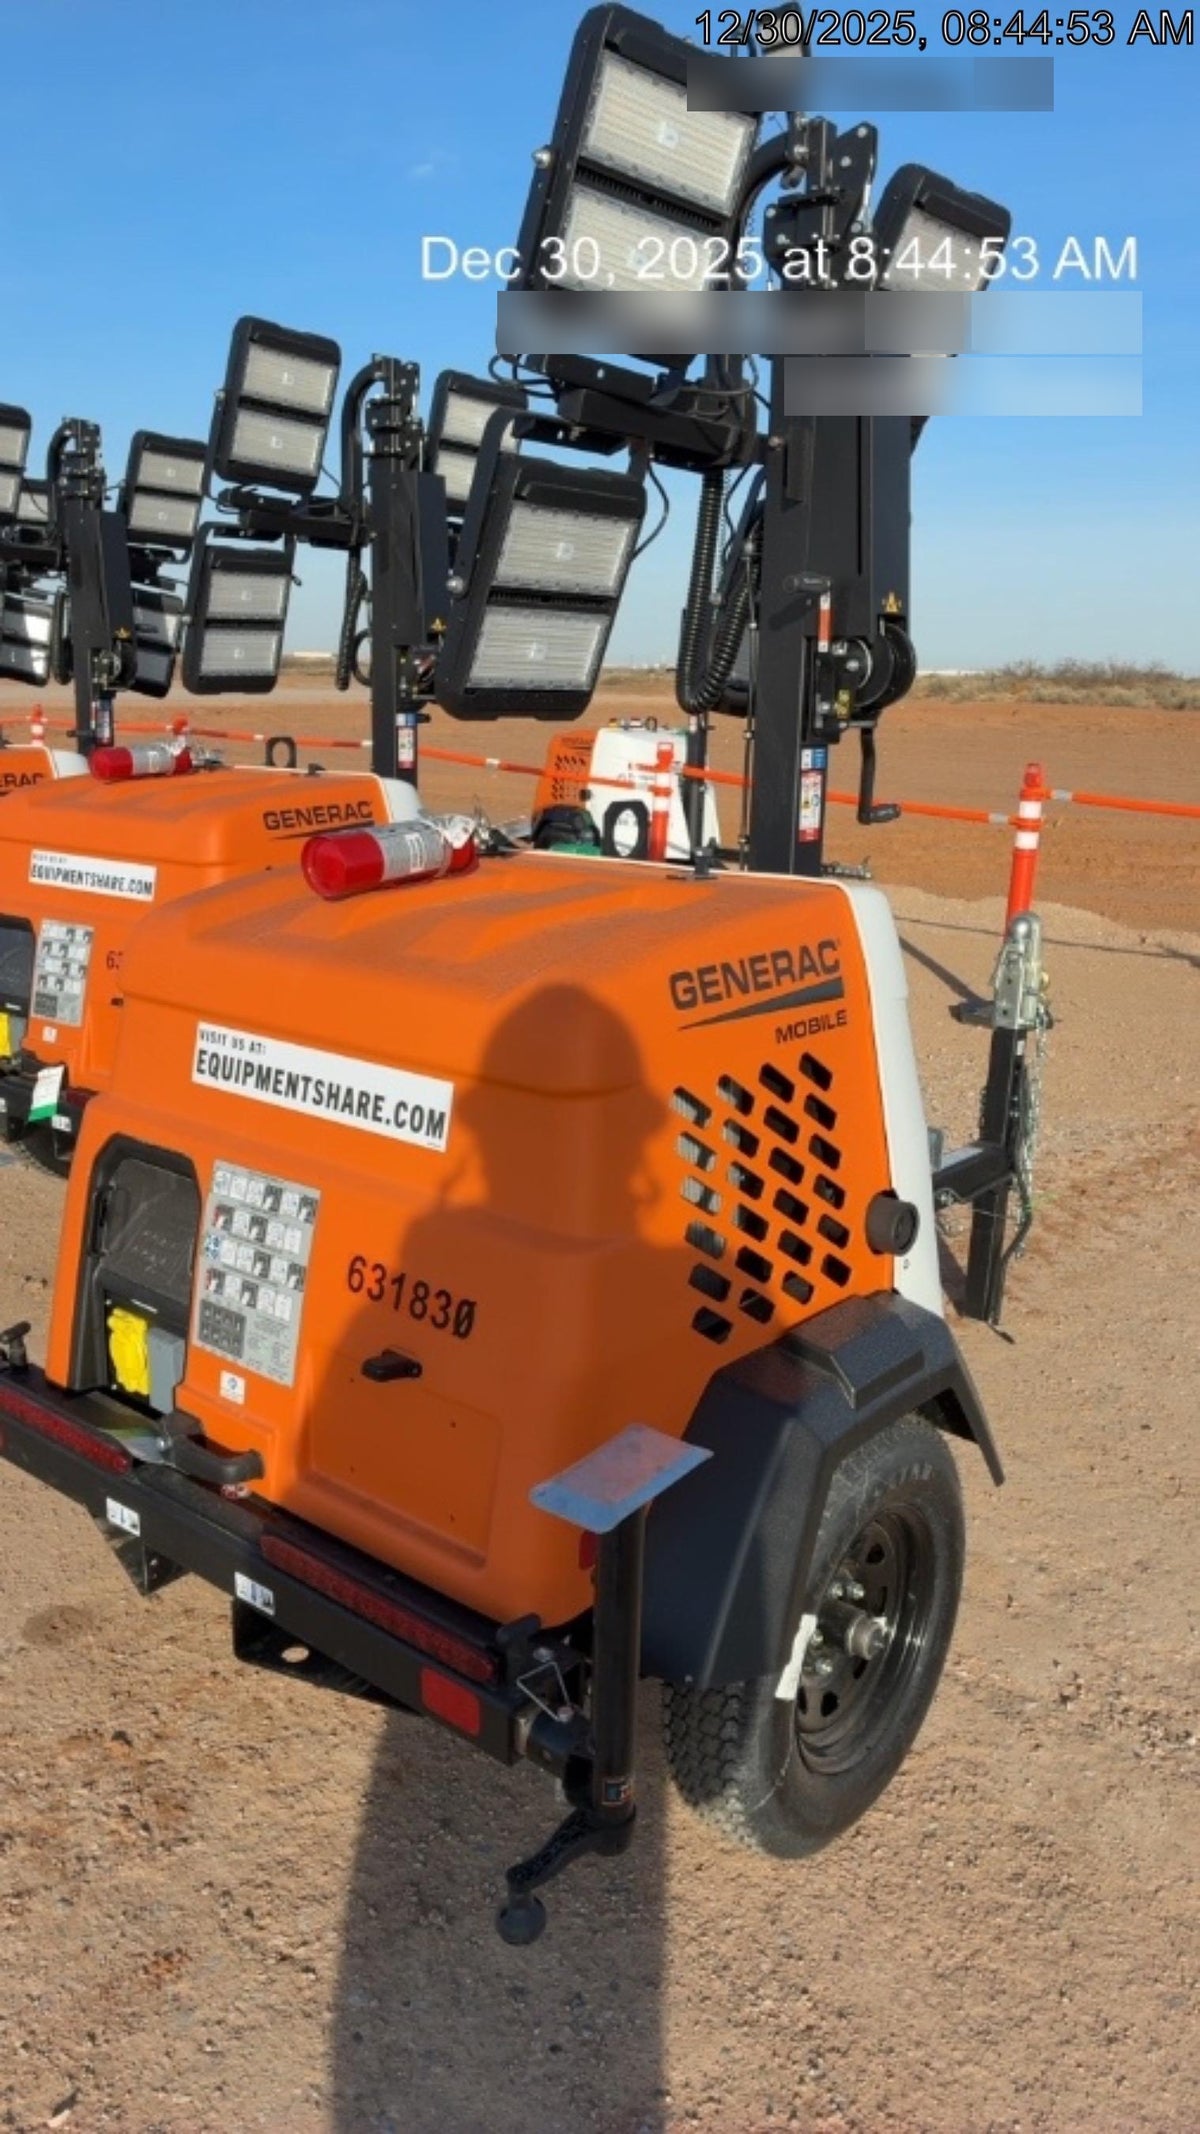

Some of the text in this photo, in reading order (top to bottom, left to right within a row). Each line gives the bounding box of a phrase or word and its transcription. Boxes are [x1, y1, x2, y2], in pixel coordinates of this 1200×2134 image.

[263, 800, 373, 831] GENERAC
[31, 865, 153, 895] EQUIPMENTSHARE.COM
[669, 939, 841, 1011] GENERAC
[200, 1028, 267, 1055] VISIT US AT:
[775, 1009, 848, 1044] MOBILE
[196, 1049, 446, 1140] EQUIPMENTSHARE.COM
[347, 1255, 477, 1340] 631830
